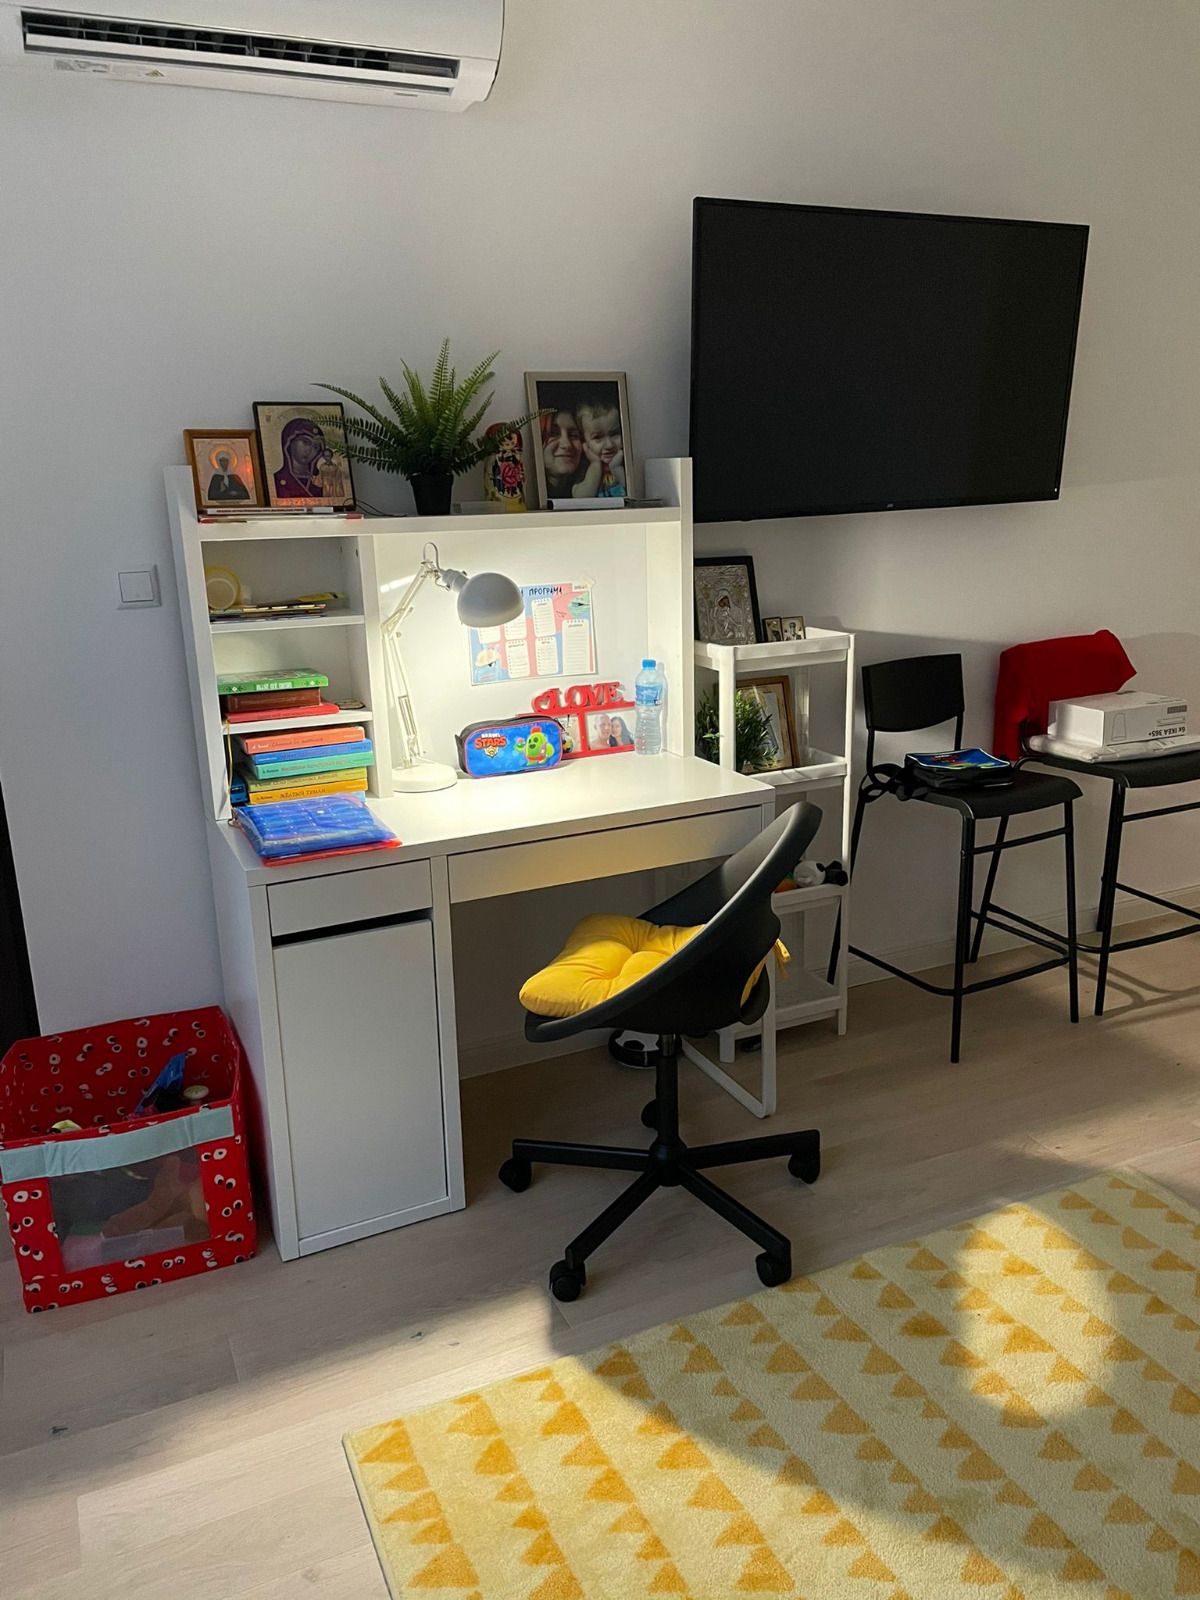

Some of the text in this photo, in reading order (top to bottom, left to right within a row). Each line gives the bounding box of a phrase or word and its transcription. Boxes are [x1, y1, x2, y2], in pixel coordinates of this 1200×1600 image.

[528, 586, 562, 596] ПРОГРАМА
[532, 682, 624, 711] LOVE
[475, 736, 507, 749] STARS
